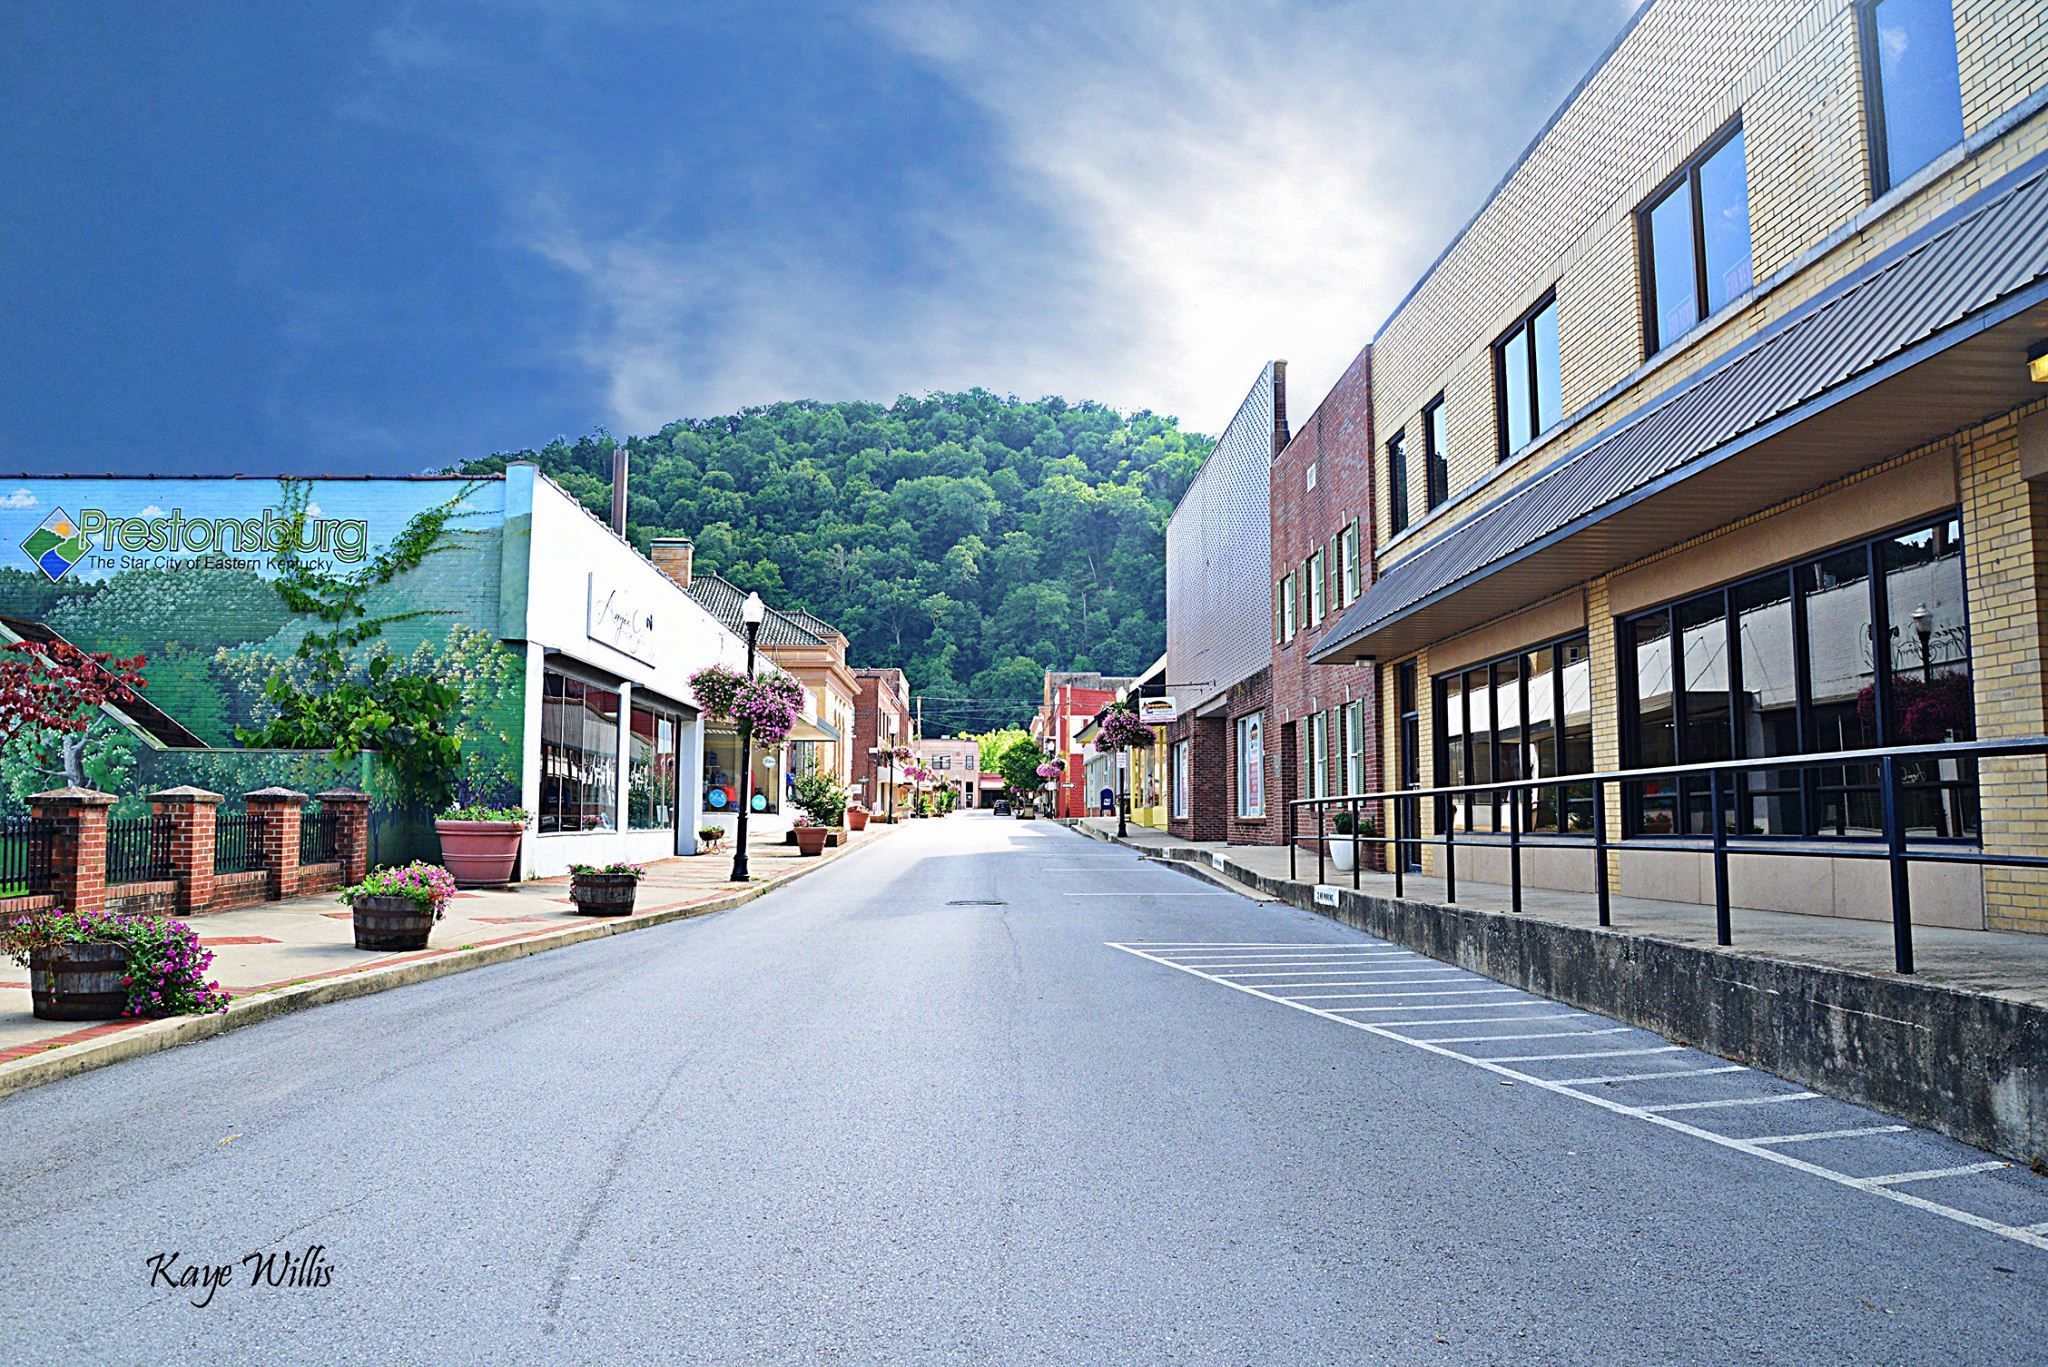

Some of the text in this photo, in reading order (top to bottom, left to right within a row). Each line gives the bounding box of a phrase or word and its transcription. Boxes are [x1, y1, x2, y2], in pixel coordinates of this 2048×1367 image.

[79, 508, 368, 563] Prestonsburg
[88, 555, 115, 569] The
[120, 555, 150, 569] Star
[154, 555, 182, 572] City
[186, 555, 201, 569] of
[204, 556, 261, 569] Eastern
